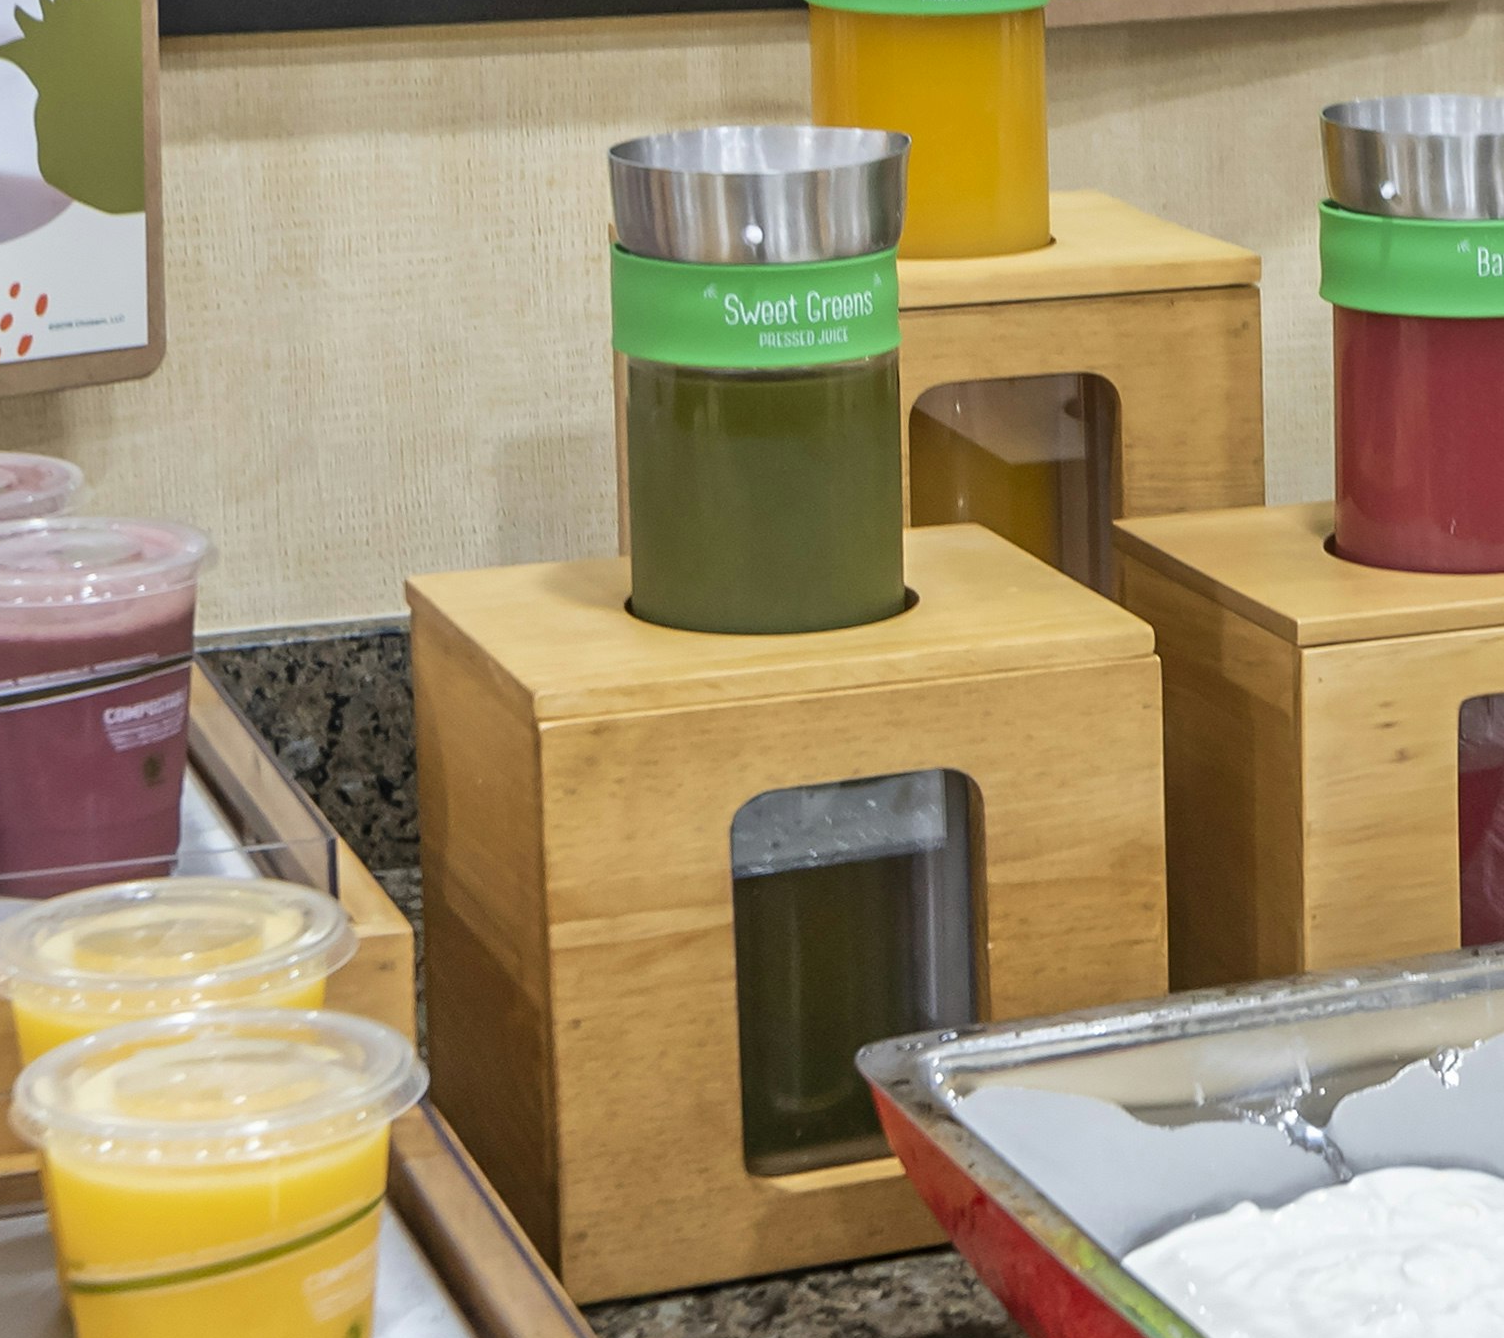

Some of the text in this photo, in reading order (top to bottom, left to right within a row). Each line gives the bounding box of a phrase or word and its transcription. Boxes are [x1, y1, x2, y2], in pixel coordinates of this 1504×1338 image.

[724, 289, 874, 326] Sweet Greens
[759, 326, 848, 348] PRESSED JUICE
